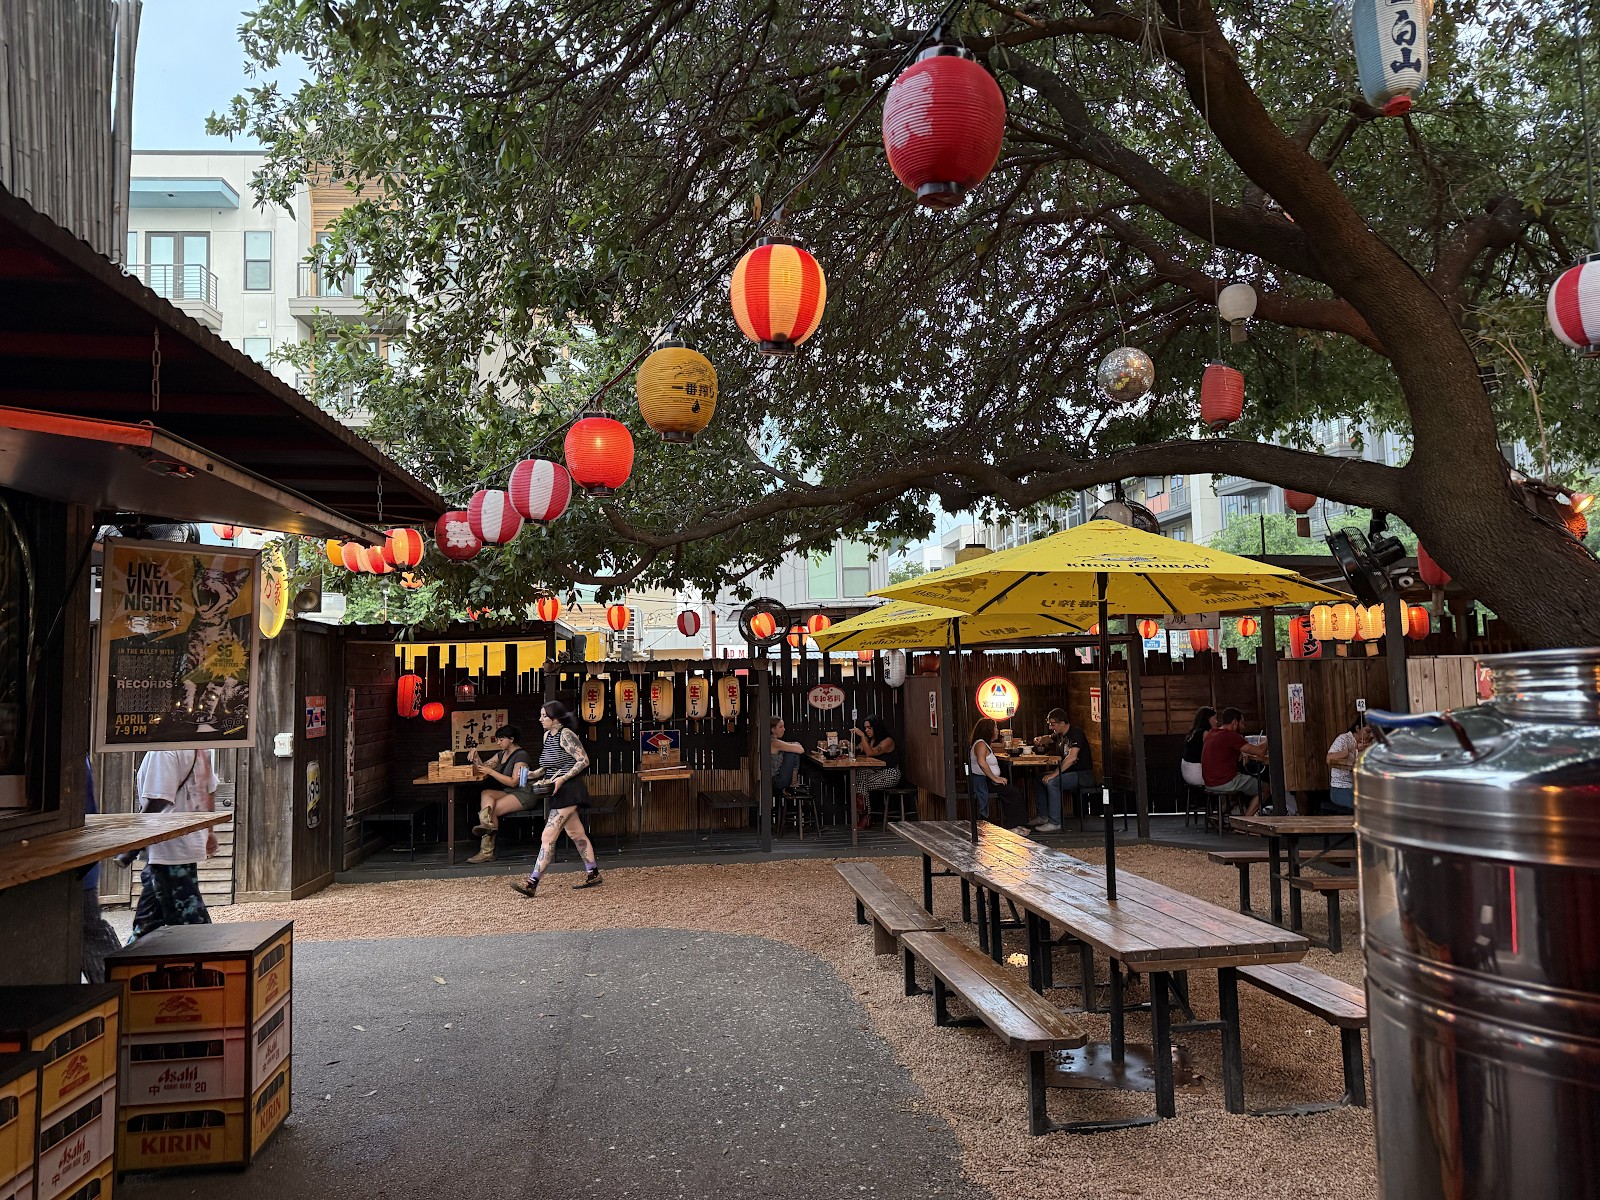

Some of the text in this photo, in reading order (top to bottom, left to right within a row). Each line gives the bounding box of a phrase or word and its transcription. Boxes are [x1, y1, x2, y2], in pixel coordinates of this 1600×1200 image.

[671, 381, 715, 399] 一番搾り
[128, 562, 162, 579] LIVE
[127, 579, 173, 596] VINYL
[125, 595, 183, 612] NIGHTS
[217, 644, 233, 658] $5
[117, 680, 174, 689] RECORDS
[587, 688, 598, 720] 生ビール
[623, 688, 634, 719] 生ビール
[689, 685, 700, 716] 生ビール
[728, 685, 739, 716] 生ビール
[1358, 701, 1365, 709] 42
[116, 714, 147, 725] APRIL
[115, 725, 147, 736] 7-9 PM
[158, 1066, 198, 1083] Asahi
[148, 1083, 160, 1097] 中
[194, 1081, 207, 1093] 20
[260, 1096, 281, 1133] KIRIN
[58, 1134, 86, 1170] Asahi
[141, 1131, 212, 1156] KIRIN
[82, 1150, 91, 1166] 20
